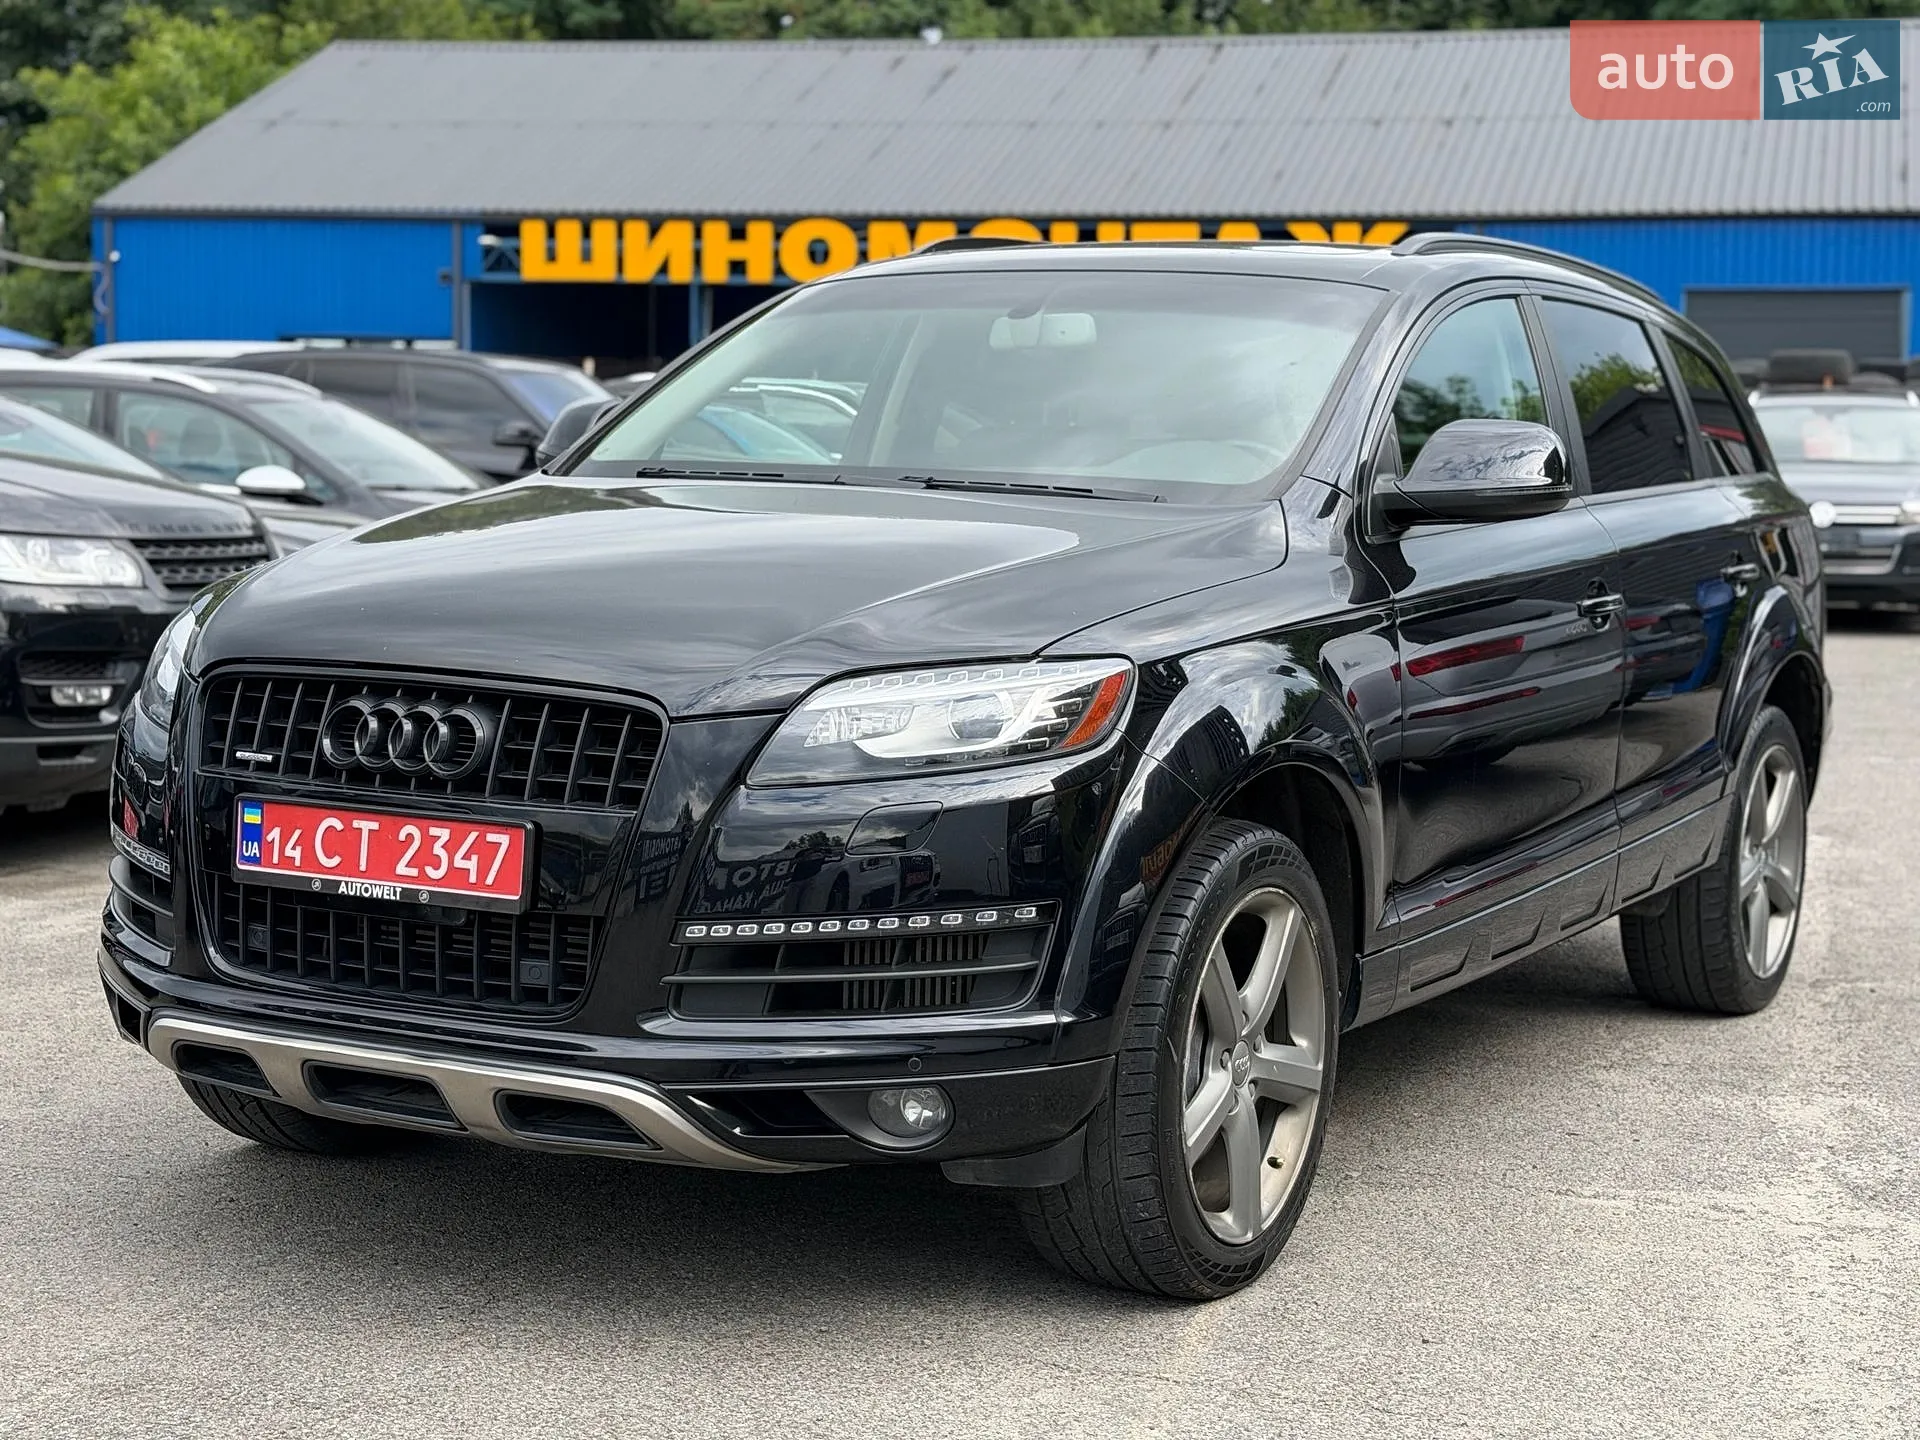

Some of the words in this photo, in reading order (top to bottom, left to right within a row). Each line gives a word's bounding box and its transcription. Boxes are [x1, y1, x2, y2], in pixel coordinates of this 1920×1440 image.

[519, 217, 1410, 284] ШИНОМ
[242, 840, 260, 858] UA
[265, 826, 302, 867] 14
[395, 824, 511, 886] 2347
[337, 880, 403, 901] AUTOWELT
